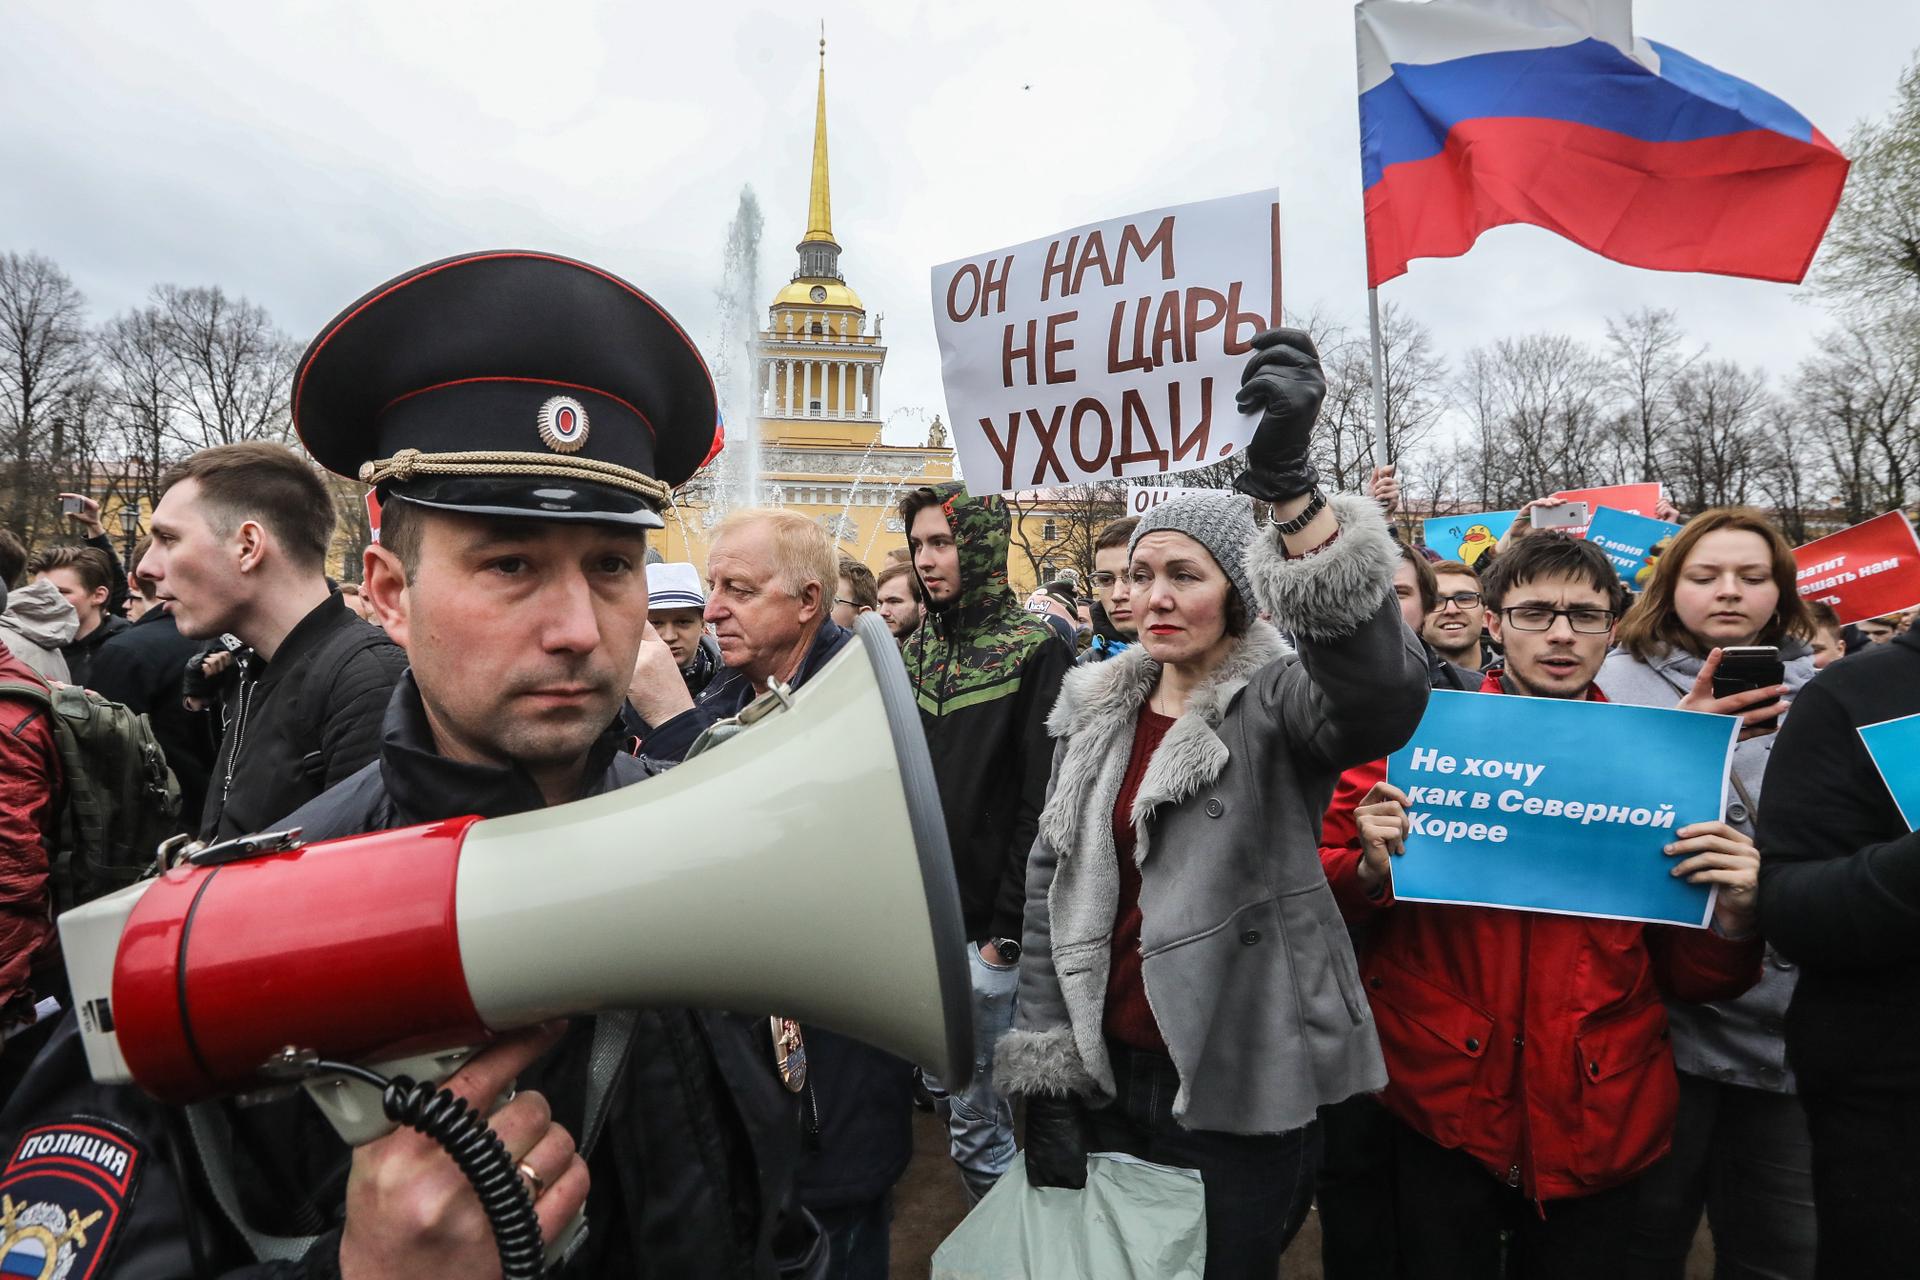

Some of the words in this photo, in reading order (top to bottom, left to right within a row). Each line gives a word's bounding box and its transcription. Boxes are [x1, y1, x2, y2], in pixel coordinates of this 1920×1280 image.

[946, 255, 1015, 323] ОН
[1040, 216, 1176, 302] НАМ
[1002, 310, 1079, 387] НЕ
[979, 376, 1234, 490] УХОДИ.
[1593, 534, 1605, 546] С
[1605, 540, 1645, 556] меня
[1796, 556, 1846, 581] ватит
[1796, 571, 1857, 596] ешать
[1858, 557, 1899, 578] нам
[1410, 747, 1457, 774] Не
[1460, 757, 1546, 787] хочу
[1407, 785, 1468, 808] как
[1470, 791, 1491, 810] в
[1497, 788, 1676, 829] Северной
[1407, 811, 1509, 843] Корее
[18, 1133, 129, 1177] ПОЛИЦИЯ
